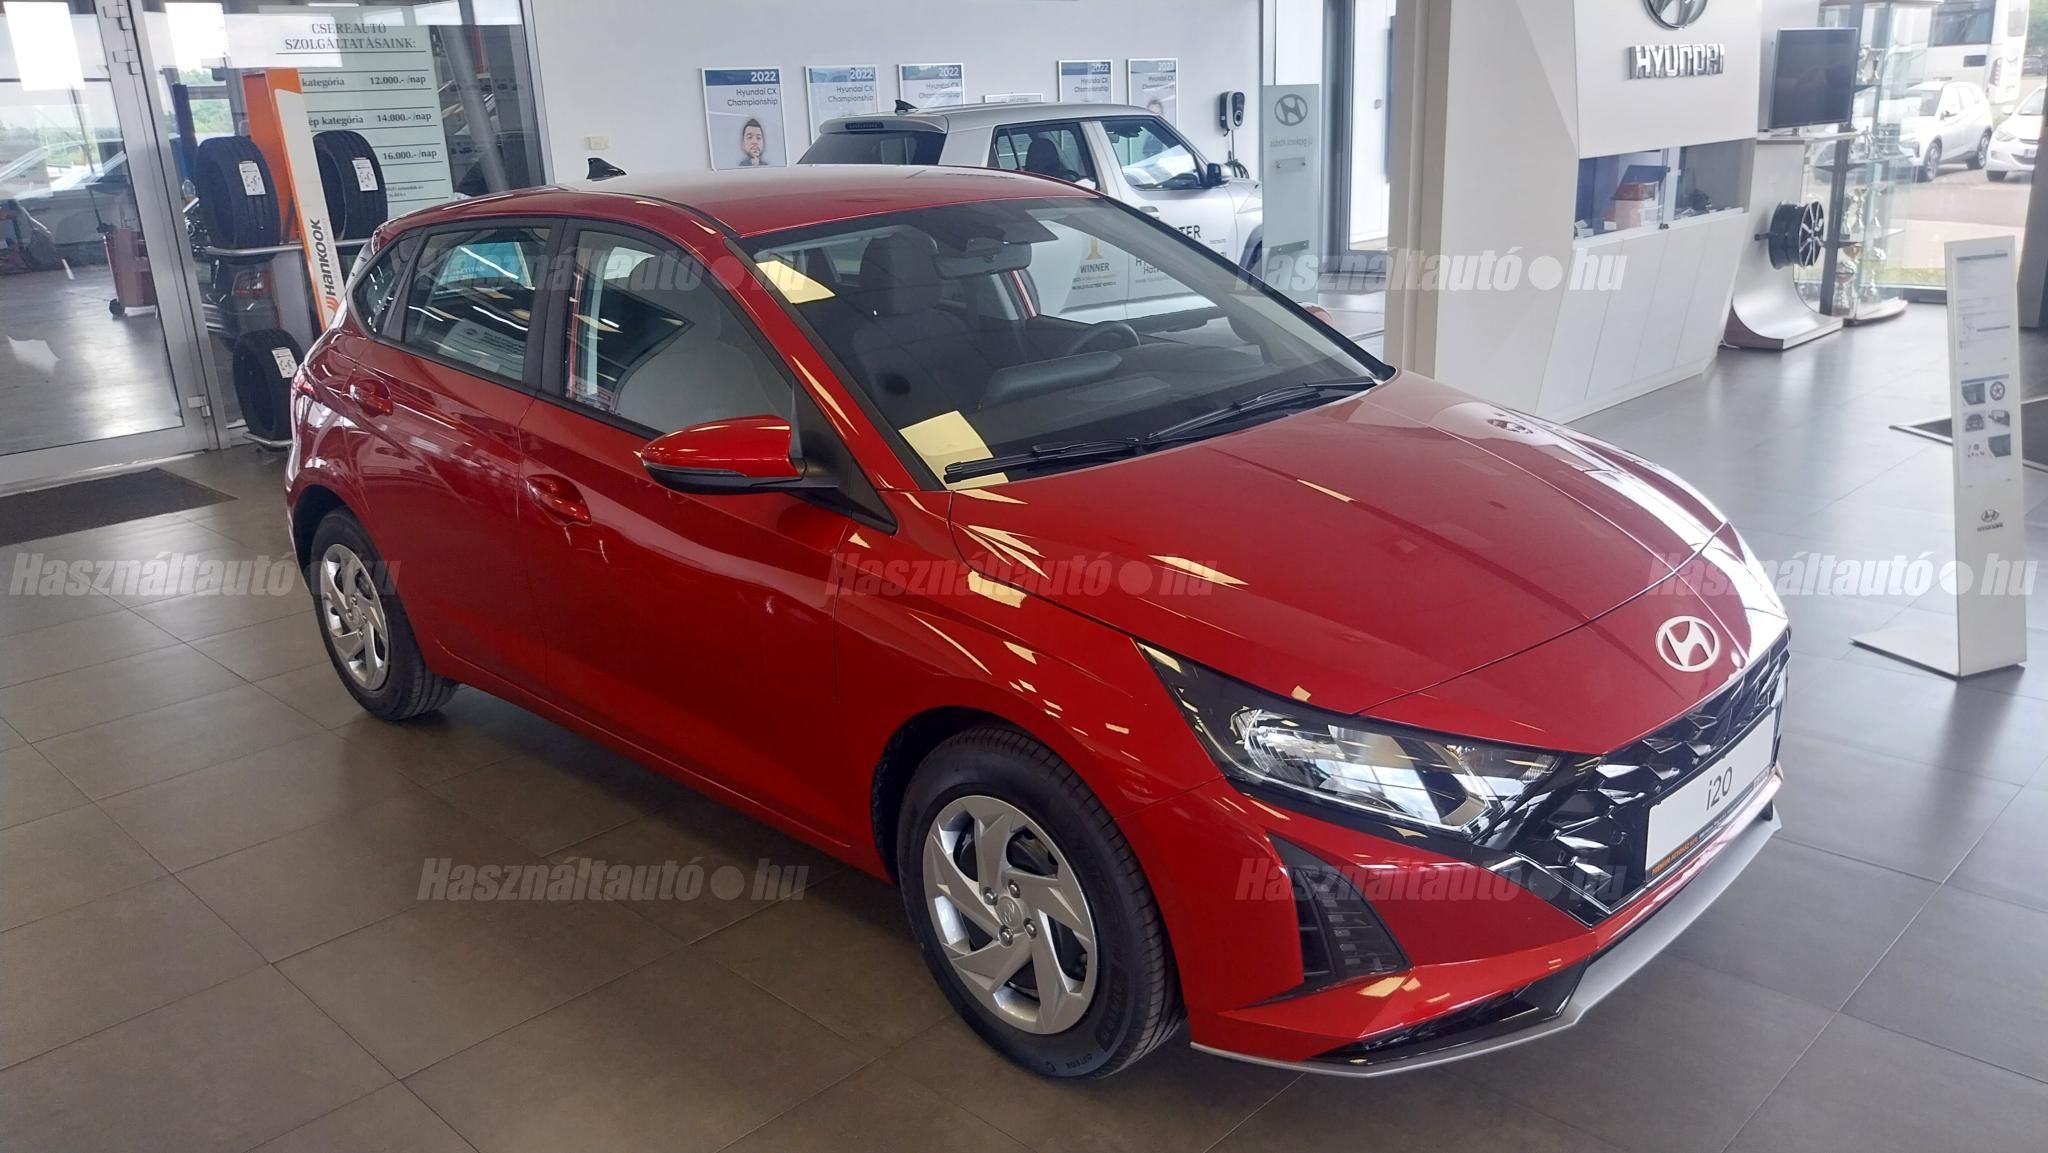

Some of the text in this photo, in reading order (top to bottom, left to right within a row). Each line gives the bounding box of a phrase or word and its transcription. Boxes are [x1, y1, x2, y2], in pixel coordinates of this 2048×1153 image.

[311, 21, 387, 35] CSEREAUTÓ
[285, 37, 416, 50] SZOLGÁLTATÁSAINK:
[1629, 43, 1725, 80] HYUNDAI
[938, 66, 960, 77] 2022
[1090, 63, 1110, 73] 2022
[751, 71, 777, 82] 2022
[849, 69, 873, 80] 2022
[302, 77, 345, 88] kategória
[736, 87, 777, 98] Hyundai CX
[836, 85, 864, 95] Hyundai
[727, 97, 778, 107] Championship
[828, 94, 874, 103] Championship
[322, 116, 364, 127] kategória
[1080, 262, 1110, 274] WINNER
[1706, 766, 1732, 811] i20
